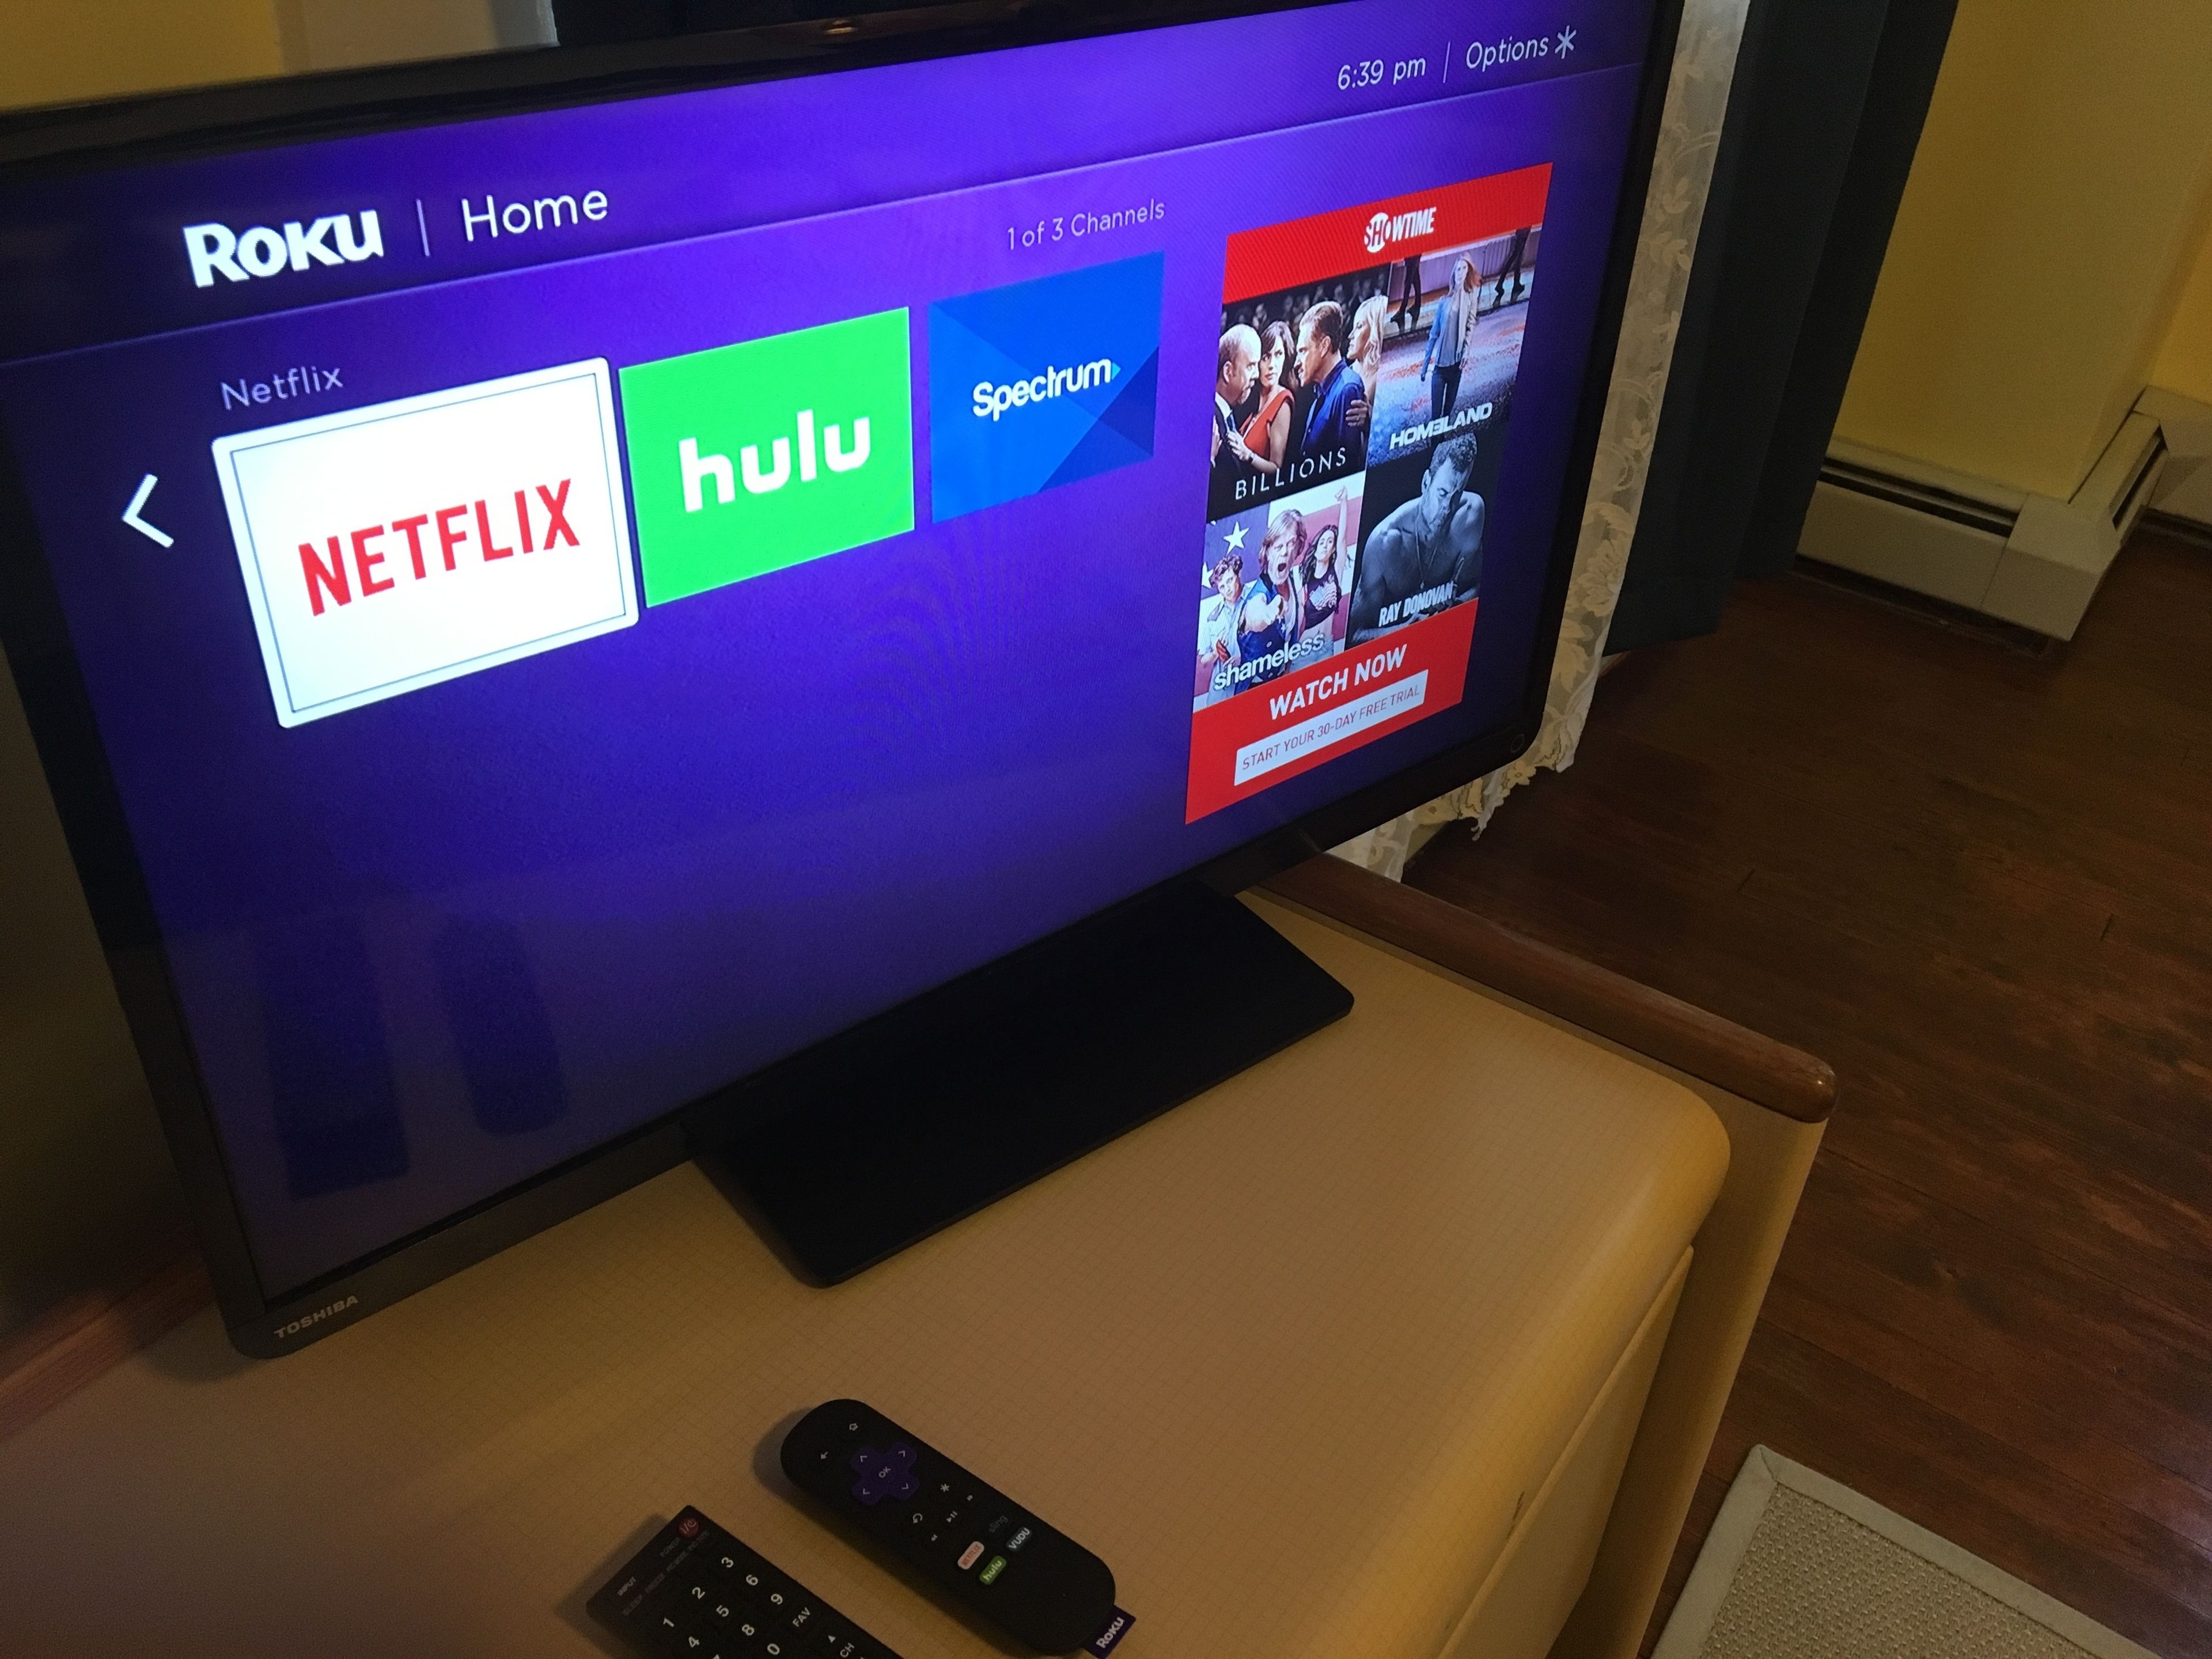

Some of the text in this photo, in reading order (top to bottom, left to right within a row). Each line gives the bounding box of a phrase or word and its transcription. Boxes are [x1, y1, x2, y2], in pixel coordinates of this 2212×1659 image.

[1338, 58, 1426, 90] 6:39 pm
[1466, 36, 1548, 72] Options
[462, 190, 607, 241] Home
[1007, 198, 1165, 250] 1 of 3 Channels
[1363, 206, 1437, 253] SHOWTIME
[221, 366, 343, 410] Netflix
[972, 358, 1111, 422] Spectrum
[1389, 402, 1493, 450] HOMELAND
[678, 409, 870, 513] hulu
[1235, 446, 1346, 501] BILLIONS
[298, 479, 579, 616] NETFLIX
[1378, 582, 1454, 627] RAY DONOVAN
[1213, 632, 1325, 691] shameless
[1269, 644, 1407, 720] WATCH NOW
[1243, 684, 1420, 770] START YOUR 30-DAY FREE TRIAL
[274, 1296, 358, 1338] TOSHIBA
[878, 1466, 891, 1478] OK
[1008, 1527, 1031, 1550] VUDU
[617, 1576, 636, 1596] INPUT
[663, 1557, 734, 1627] 1 2 3
[982, 1560, 1002, 1581] hulu
[688, 1574, 759, 1648] 4 5 6
[741, 1593, 783, 1636] 8 9
[792, 1607, 811, 1627] FAV
[840, 1642, 855, 1658] CH
